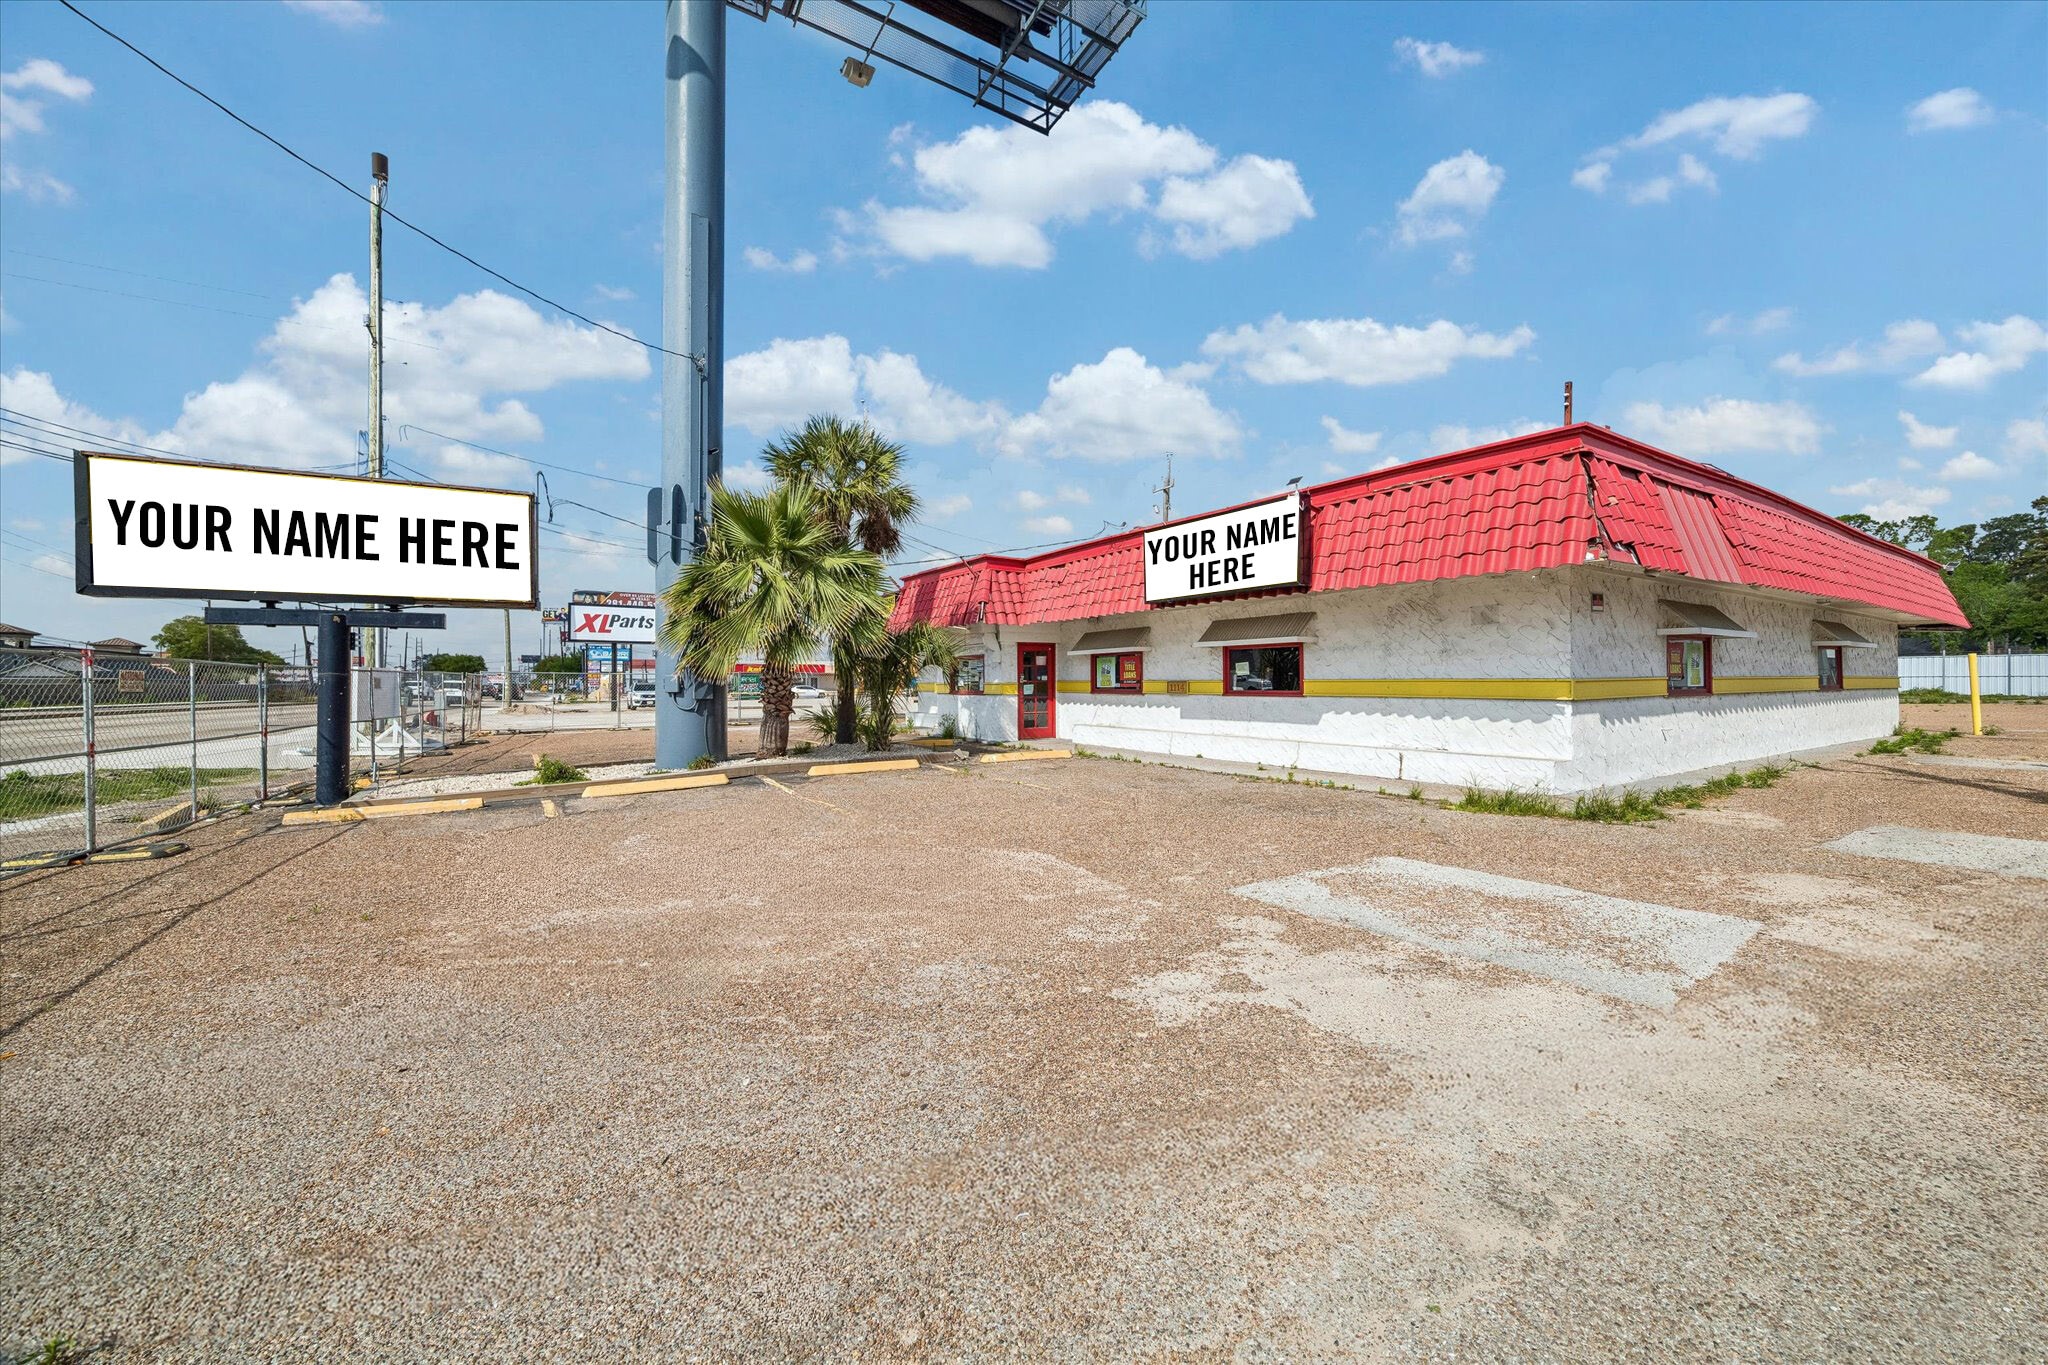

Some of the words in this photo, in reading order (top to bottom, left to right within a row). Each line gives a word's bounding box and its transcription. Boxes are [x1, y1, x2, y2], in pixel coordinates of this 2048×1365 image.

[108, 499, 233, 553] YOUR
[254, 509, 380, 560] NAME
[400, 517, 520, 570] HERE
[1148, 529, 1216, 564] YOUR
[1227, 513, 1297, 550] NAME
[1190, 552, 1256, 589] HERE
[542, 610, 557, 618] GET
[1123, 671, 1137, 679] LOANS
